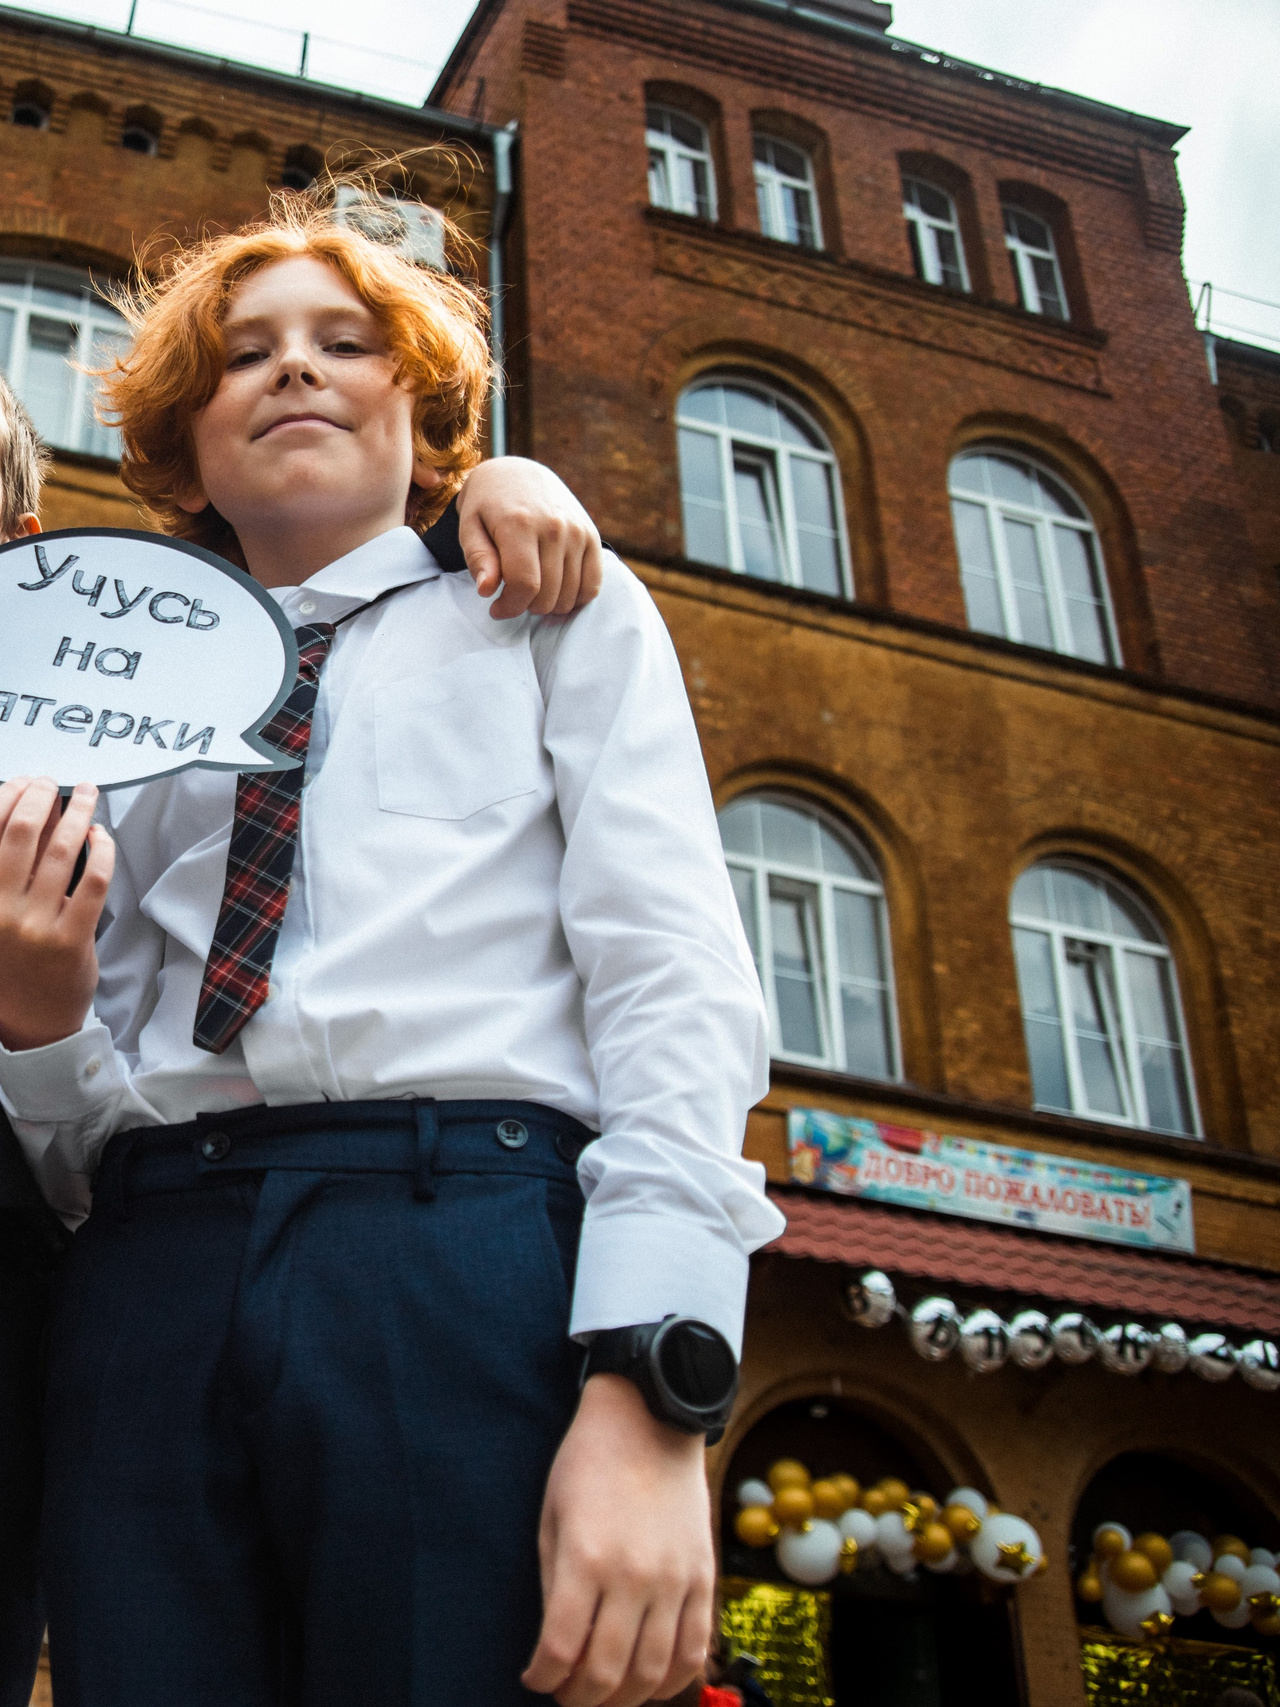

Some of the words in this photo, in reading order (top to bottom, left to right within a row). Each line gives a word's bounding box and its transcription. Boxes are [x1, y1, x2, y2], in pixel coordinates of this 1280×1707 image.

[17, 544, 220, 631] Учусь
[52, 636, 142, 680] на
[864, 1150, 955, 1195] ДОБРО
